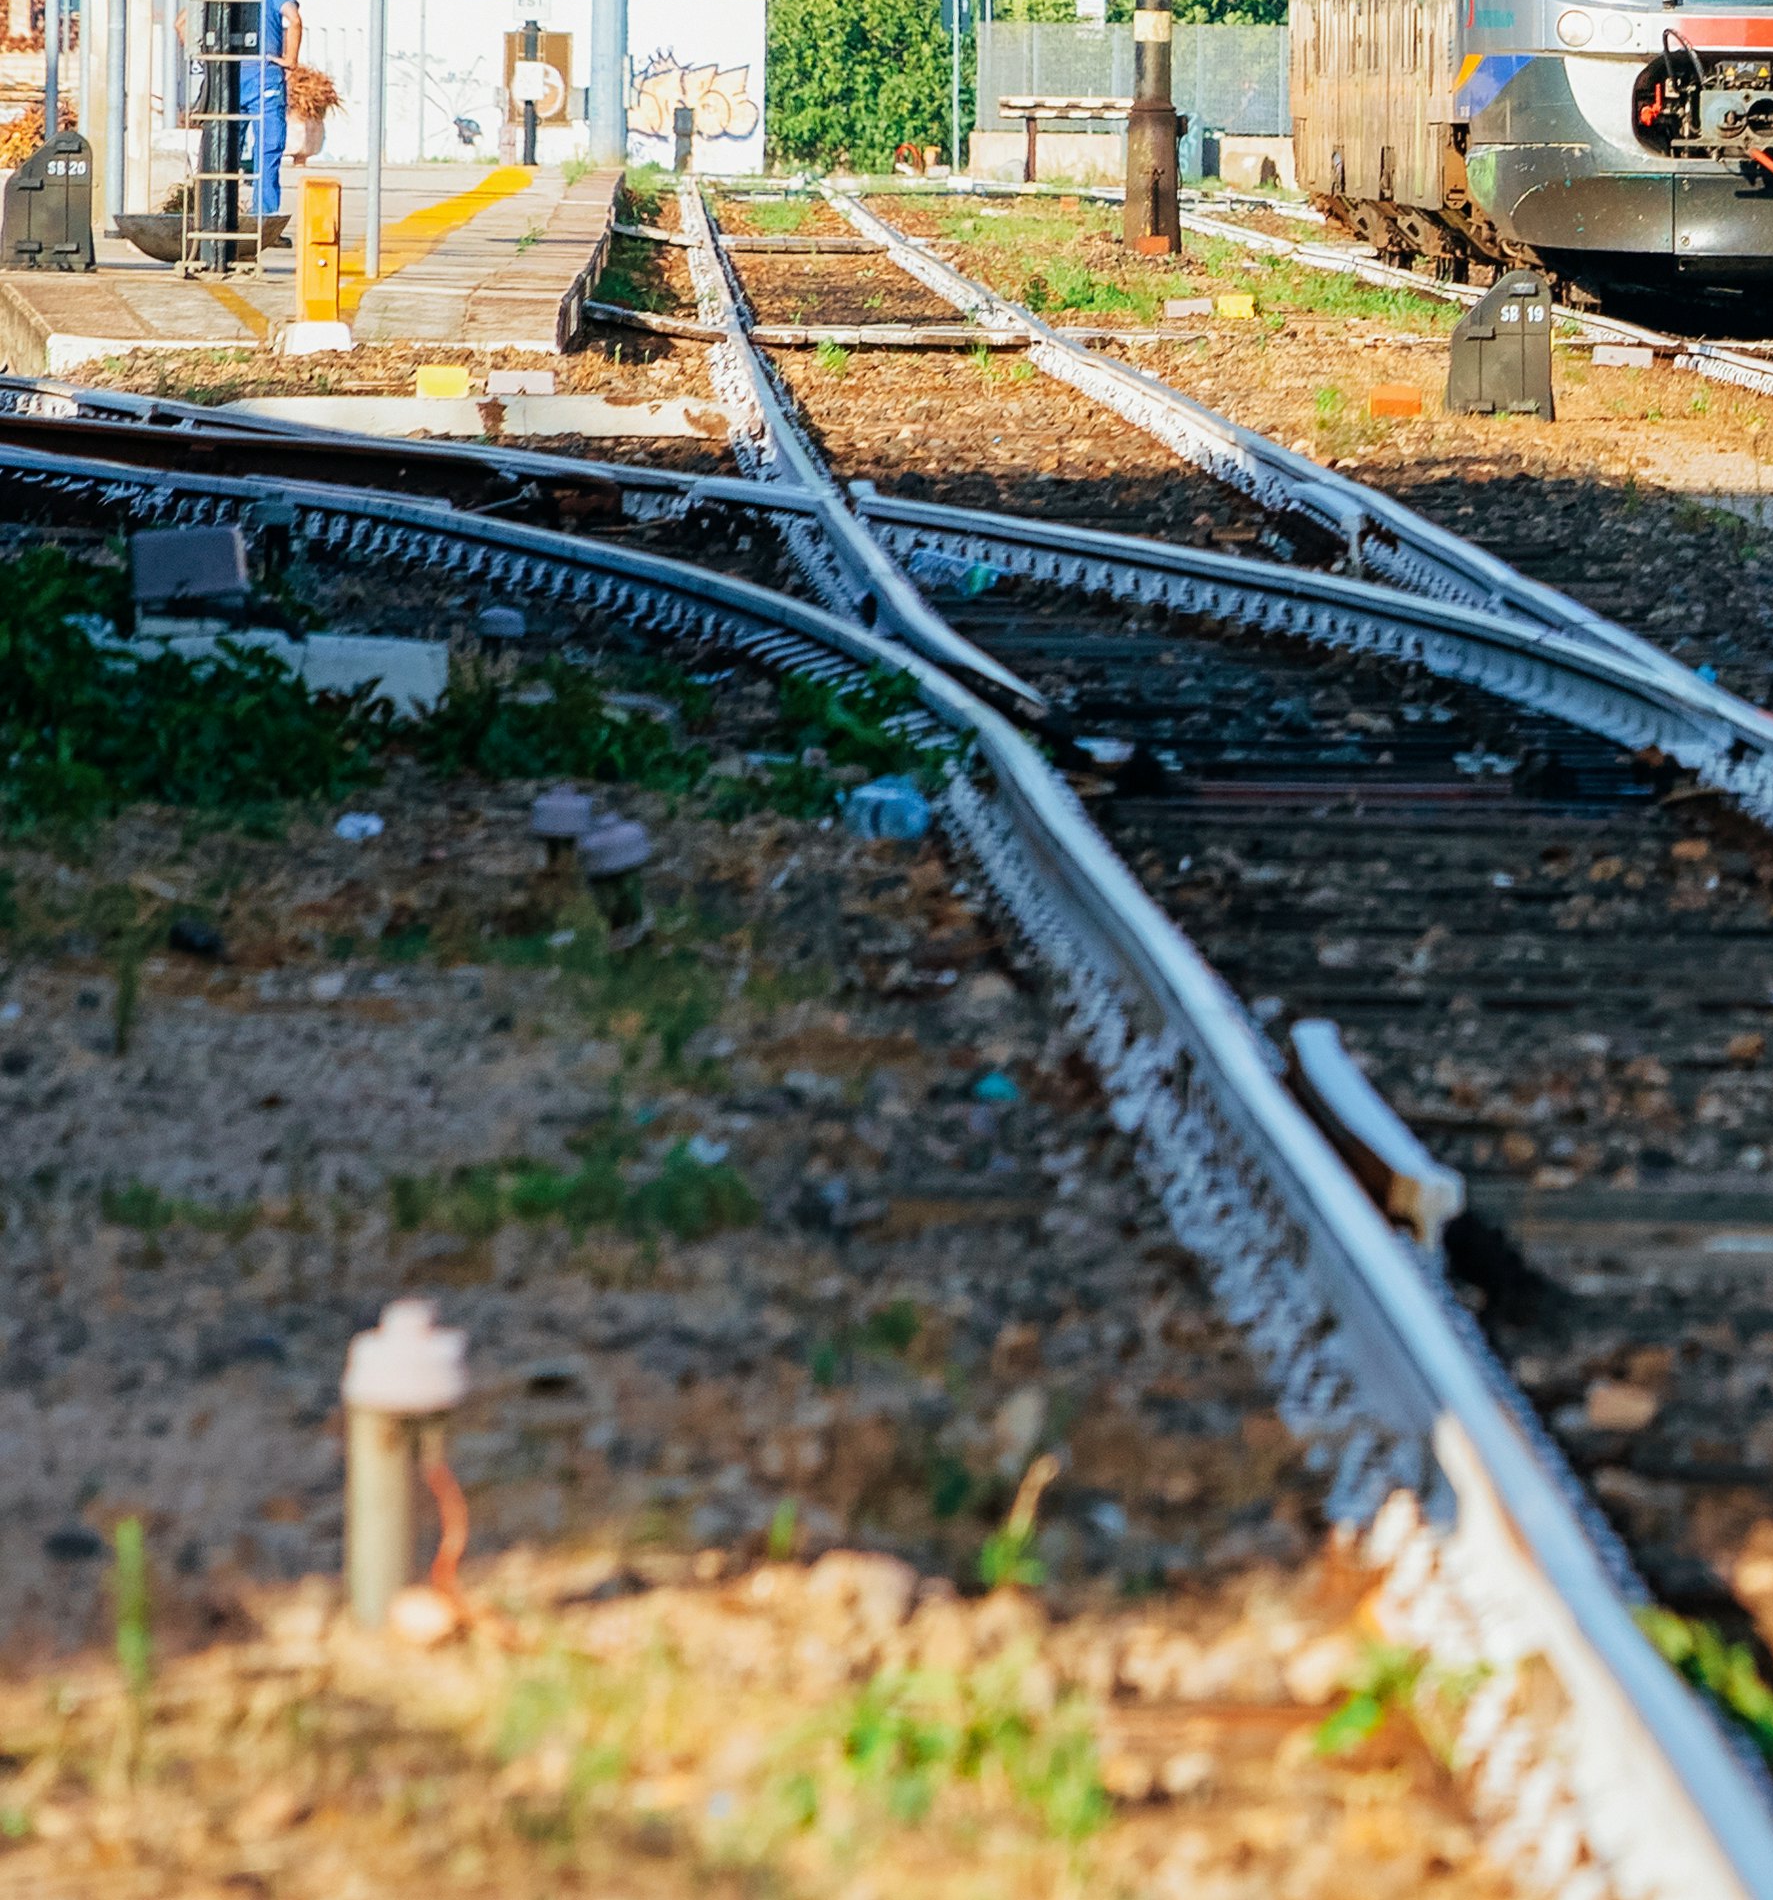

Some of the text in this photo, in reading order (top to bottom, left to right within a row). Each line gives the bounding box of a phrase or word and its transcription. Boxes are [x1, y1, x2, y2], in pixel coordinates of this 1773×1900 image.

[47, 161, 86, 175] SB 20
[1500, 305, 1544, 322] SB 19
